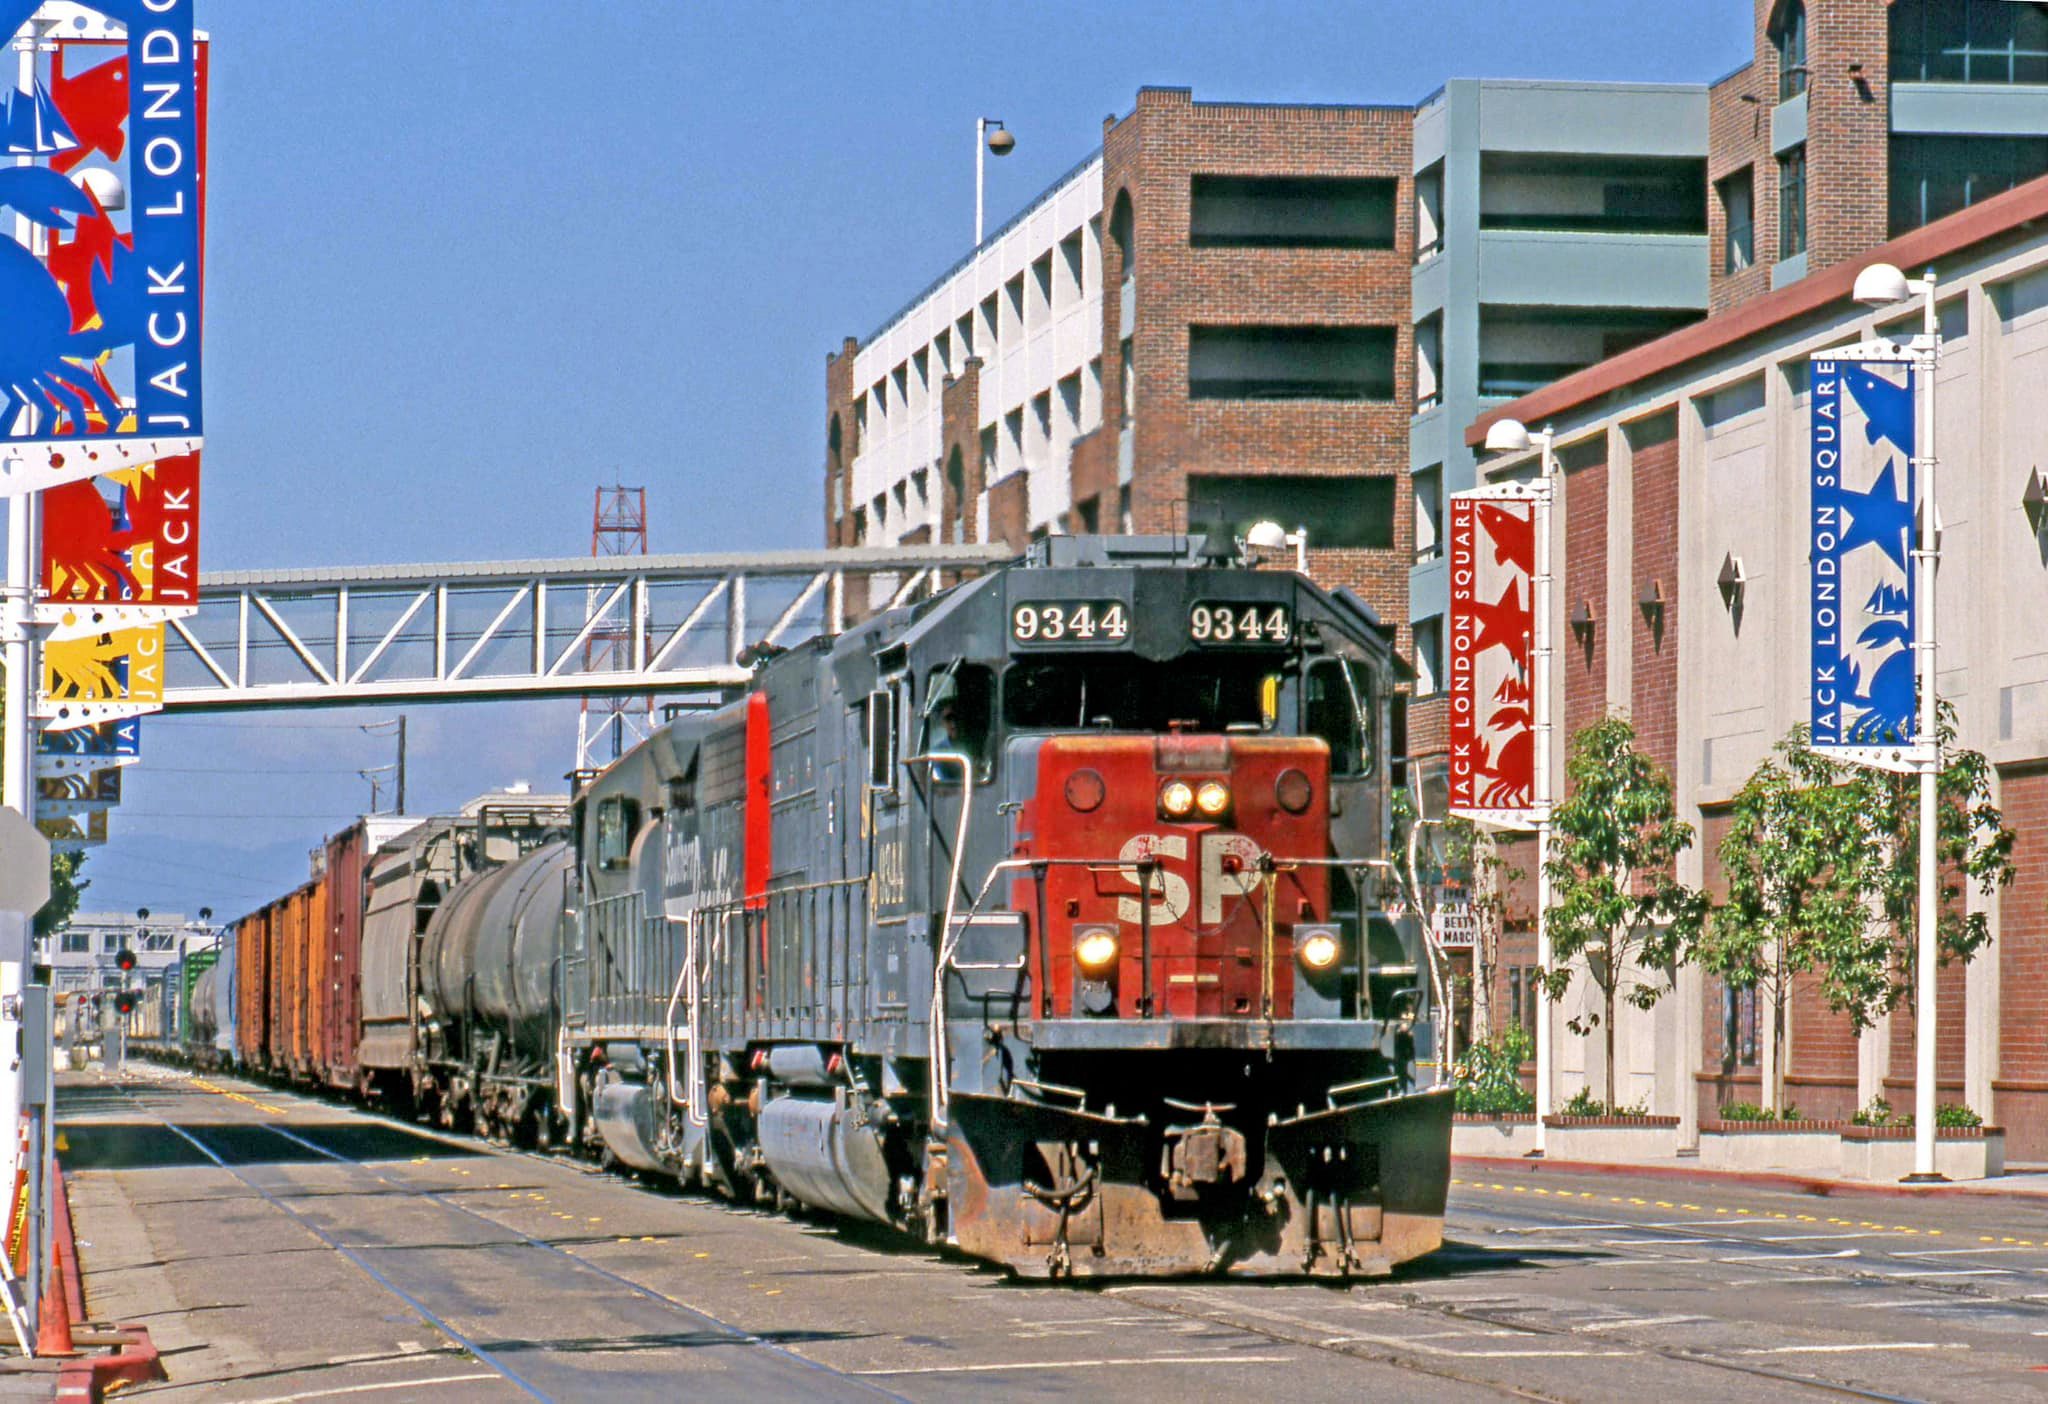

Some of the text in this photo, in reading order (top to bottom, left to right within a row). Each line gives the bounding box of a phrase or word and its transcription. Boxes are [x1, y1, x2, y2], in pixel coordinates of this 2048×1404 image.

[147, 261, 190, 430] JACK
[160, 487, 190, 600] JACK
[1816, 361, 1838, 743] JACK LONDON SQUARE
[135, 624, 158, 699] JAC
[1014, 605, 1128, 640] 9344
[1191, 607, 1289, 641] 9344
[1454, 500, 1473, 807] JACK LONDON SQUARE
[1117, 833, 1264, 926] SP
